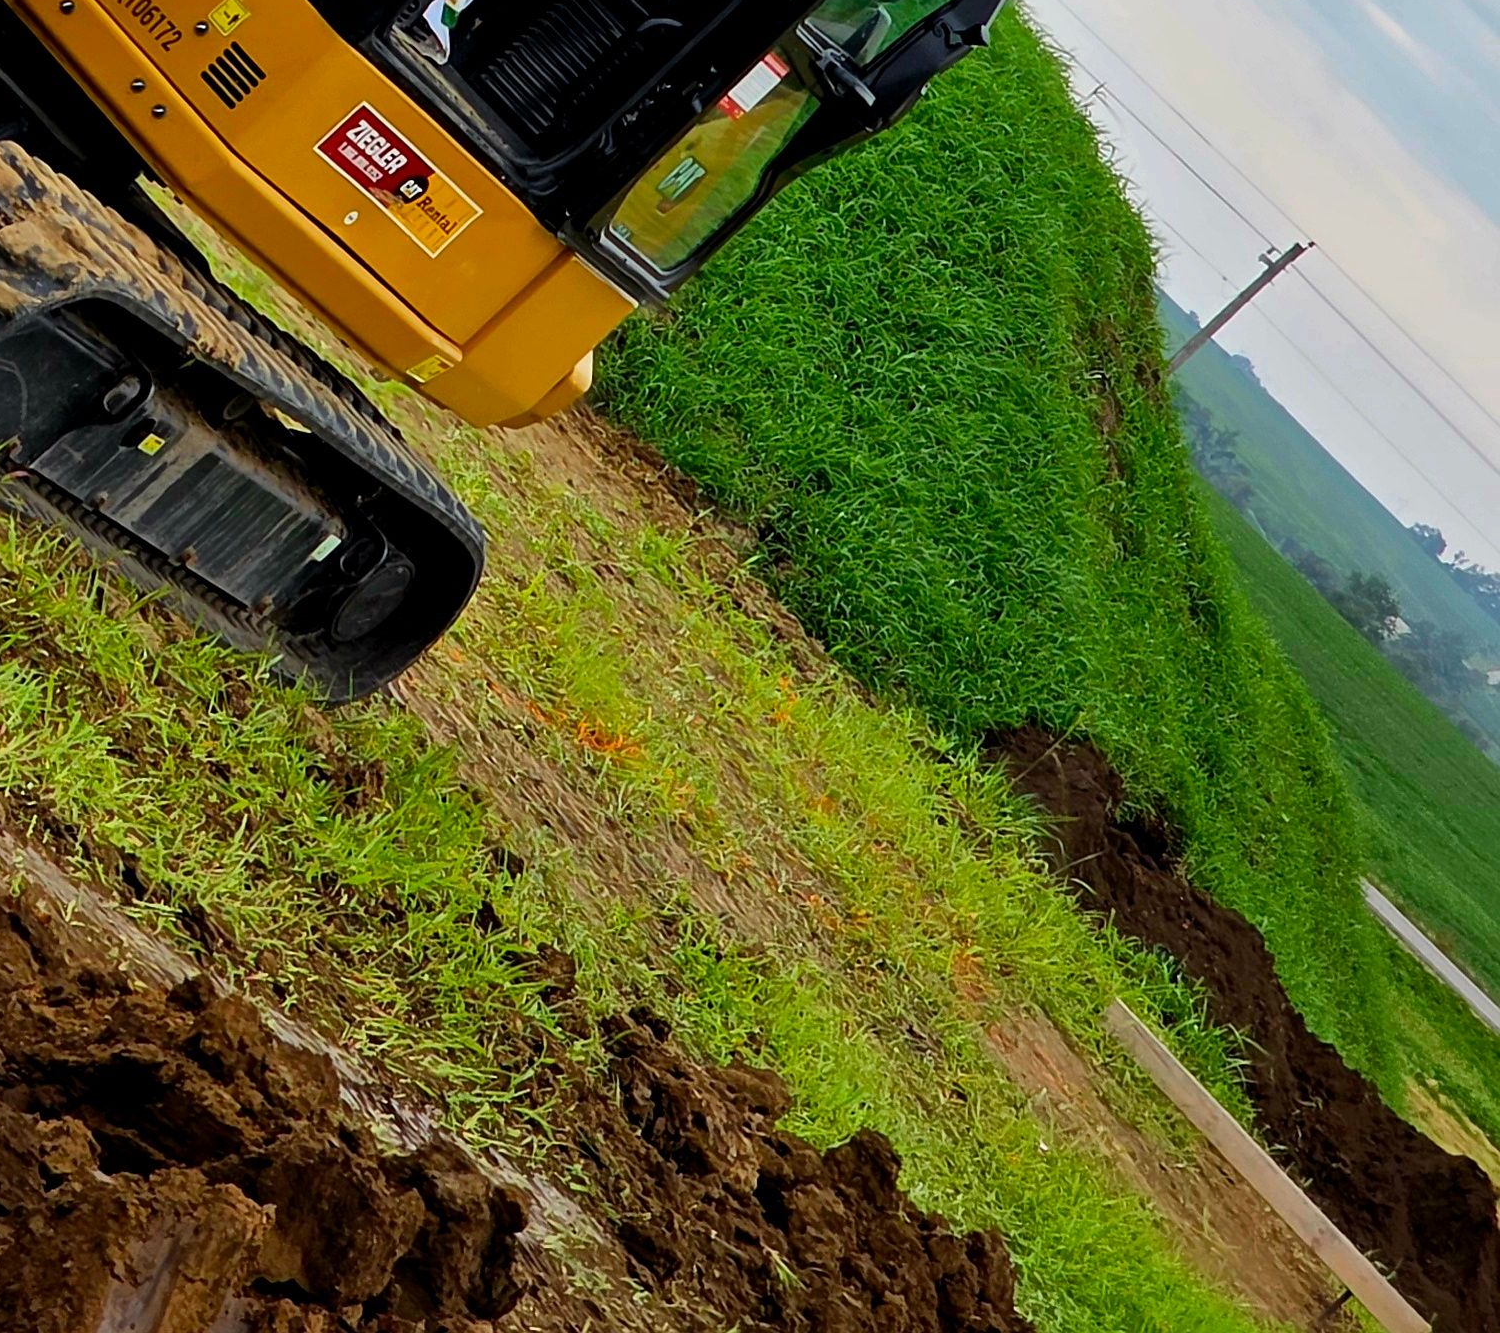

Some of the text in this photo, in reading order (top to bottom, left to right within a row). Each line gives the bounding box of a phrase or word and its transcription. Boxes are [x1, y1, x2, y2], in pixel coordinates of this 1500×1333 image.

[345, 119, 408, 175] ZIEGLER
[656, 156, 706, 200] CAT
[399, 179, 458, 236] CAT Rental
